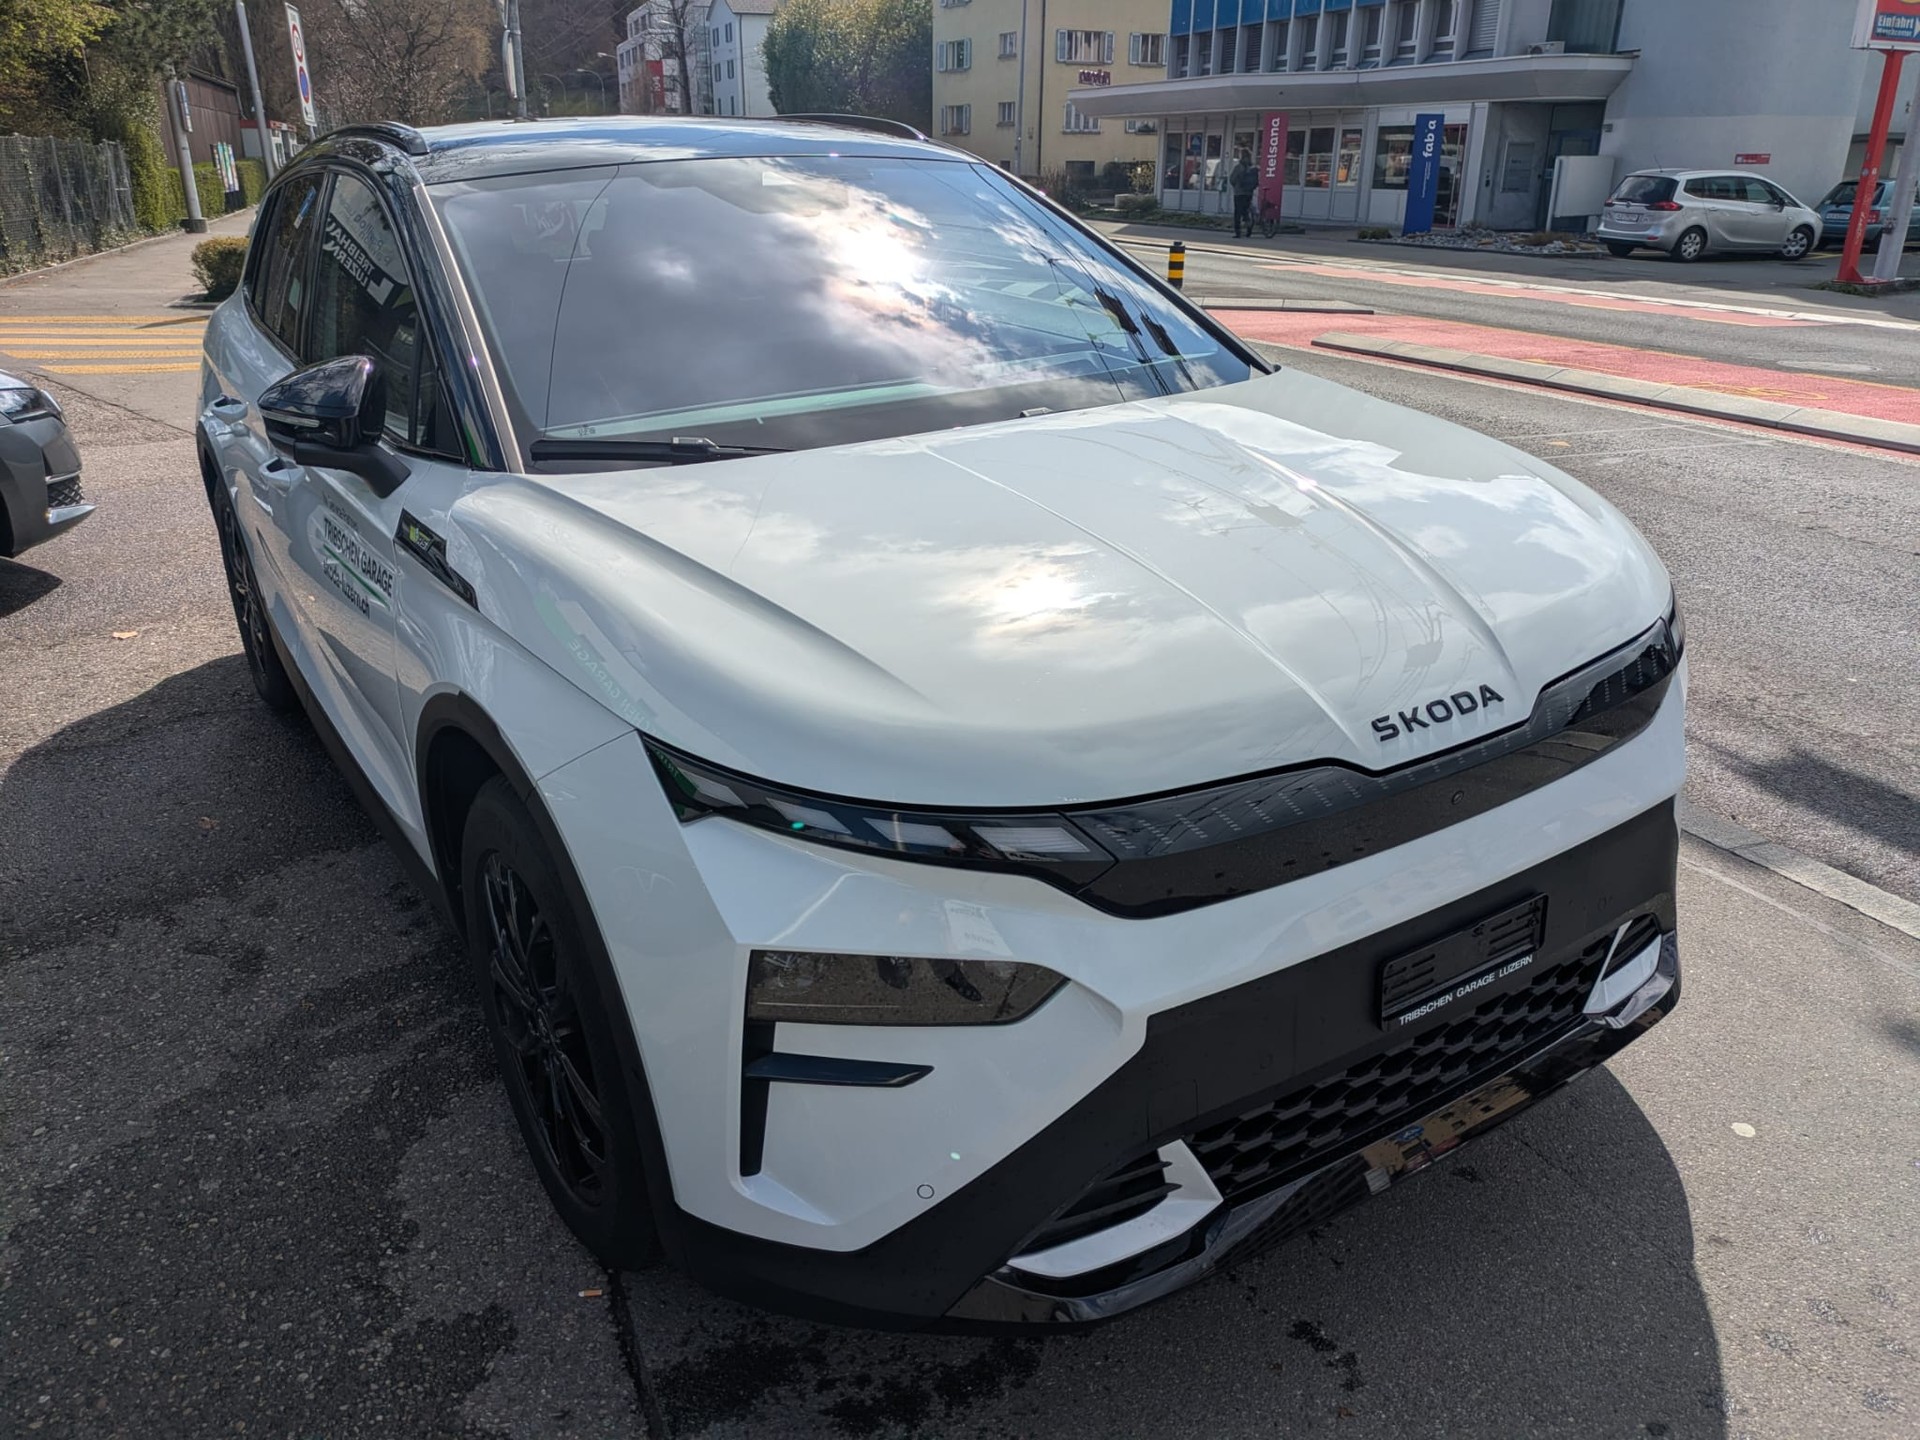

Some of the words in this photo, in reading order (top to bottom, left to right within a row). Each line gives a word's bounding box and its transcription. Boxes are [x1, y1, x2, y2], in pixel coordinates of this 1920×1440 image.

[1877, 14, 1914, 29] Einfahrt
[1265, 117, 1280, 177] Helsana
[1422, 119, 1437, 158] faba
[324, 518, 360, 568] TRIBSCHEN
[360, 551, 393, 598] GARAGE
[1371, 684, 1504, 742] SKODA
[1399, 992, 1453, 1026] TRIBSCHEN
[1456, 973, 1496, 998] GARAGE
[1499, 954, 1533, 978] LUZERN
